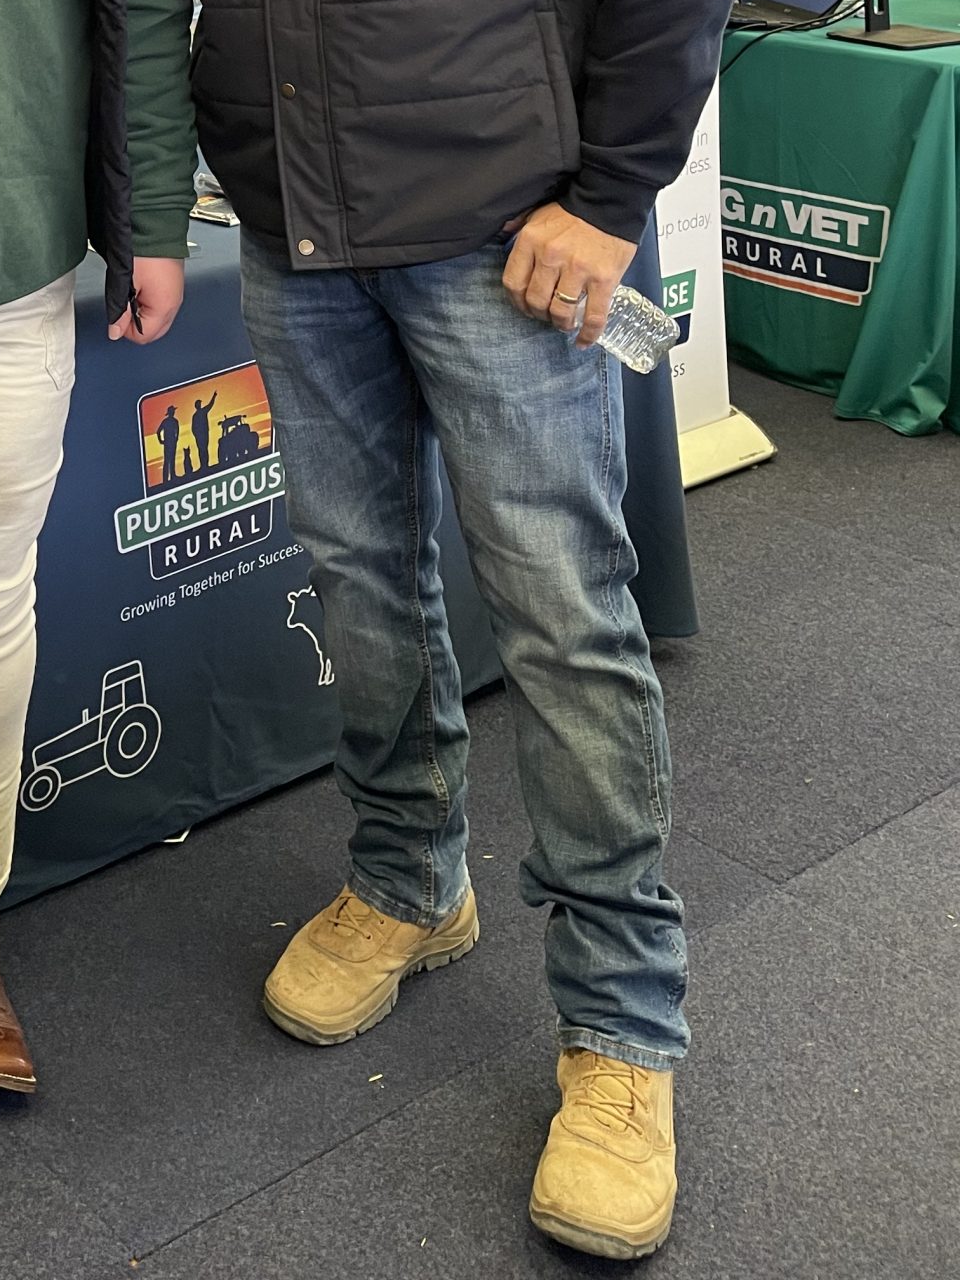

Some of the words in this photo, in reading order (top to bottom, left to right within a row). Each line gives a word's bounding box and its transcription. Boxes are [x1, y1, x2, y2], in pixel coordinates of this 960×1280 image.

[697, 130, 708, 146] in
[721, 188, 869, 246] GnVET
[726, 236, 827, 277] RURAL
[126, 463, 286, 541] PURSEHOUS
[165, 513, 261, 566] RURAL
[120, 590, 175, 622] Growing
[179, 567, 234, 601] Together
[237, 560, 255, 581] for
